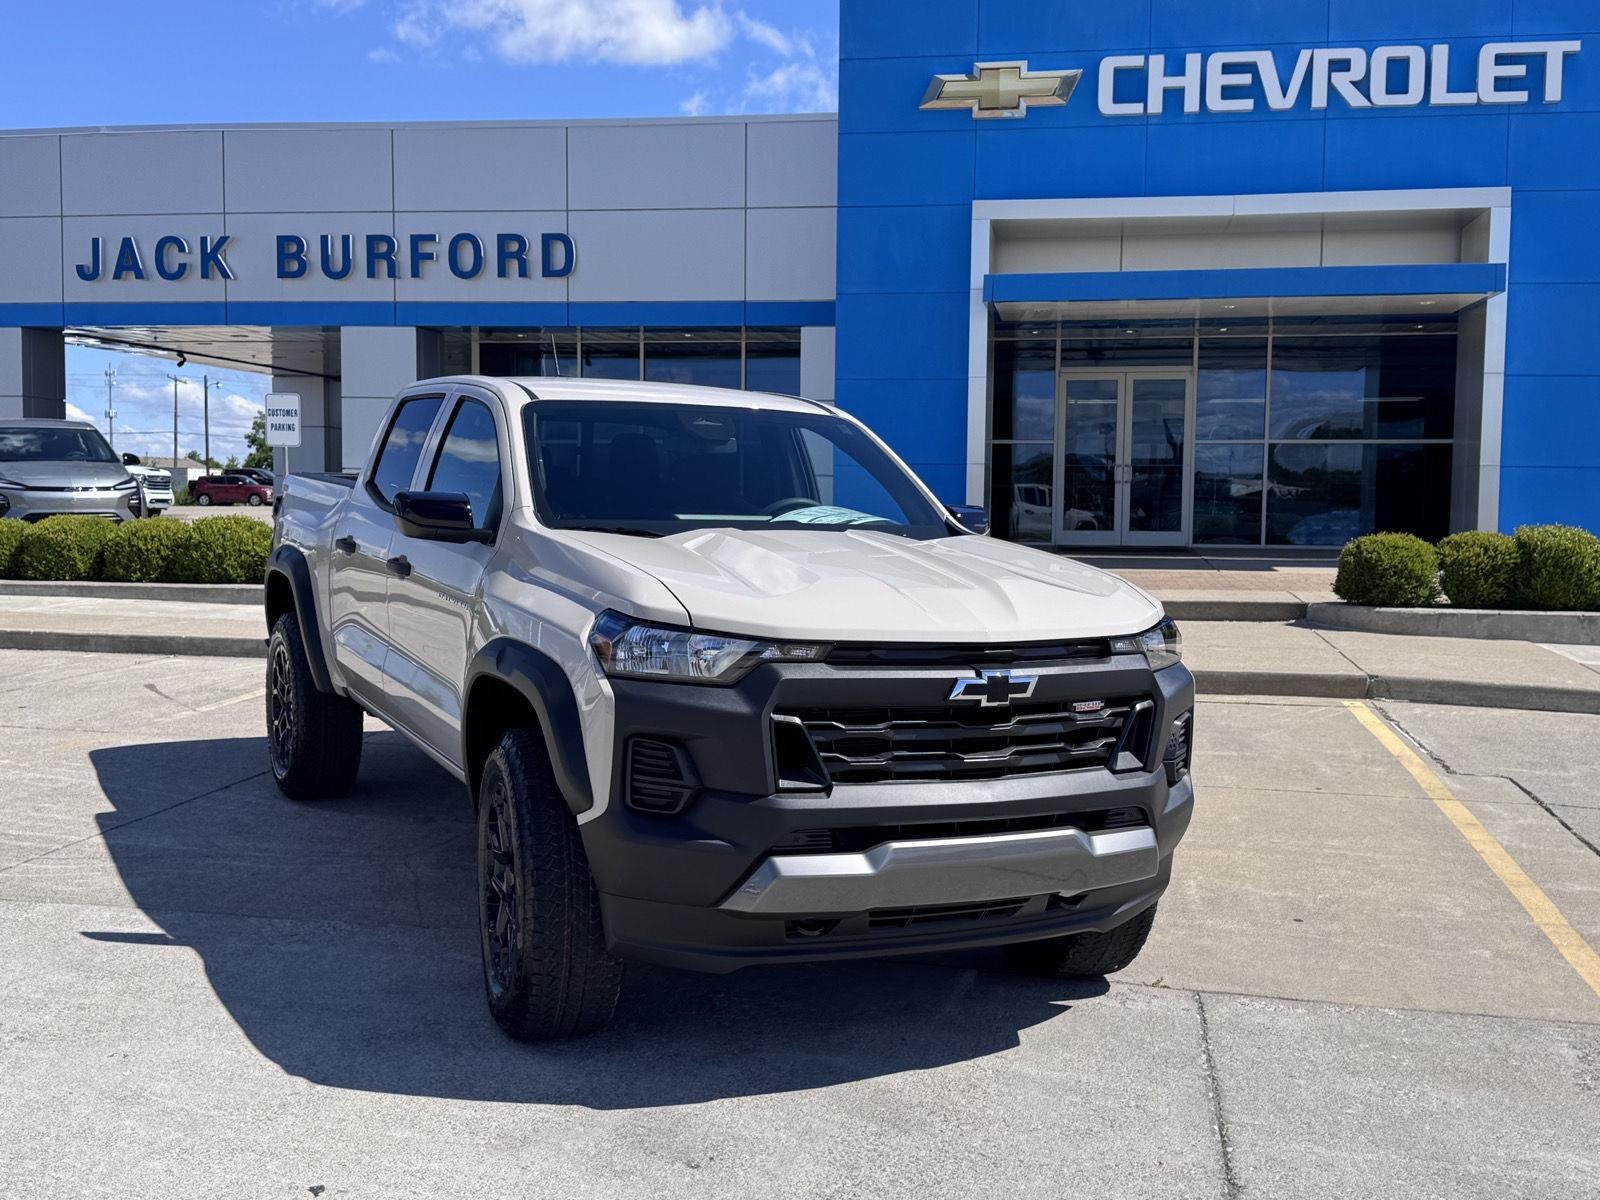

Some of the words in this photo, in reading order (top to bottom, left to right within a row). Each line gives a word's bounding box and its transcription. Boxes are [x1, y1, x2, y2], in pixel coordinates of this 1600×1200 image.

[1097, 40, 1582, 117] CHEVROLET
[75, 235, 235, 281] JACK
[276, 232, 577, 280] BURFORD
[267, 408, 298, 417] CUSTOMER
[270, 422, 296, 432] PARKING
